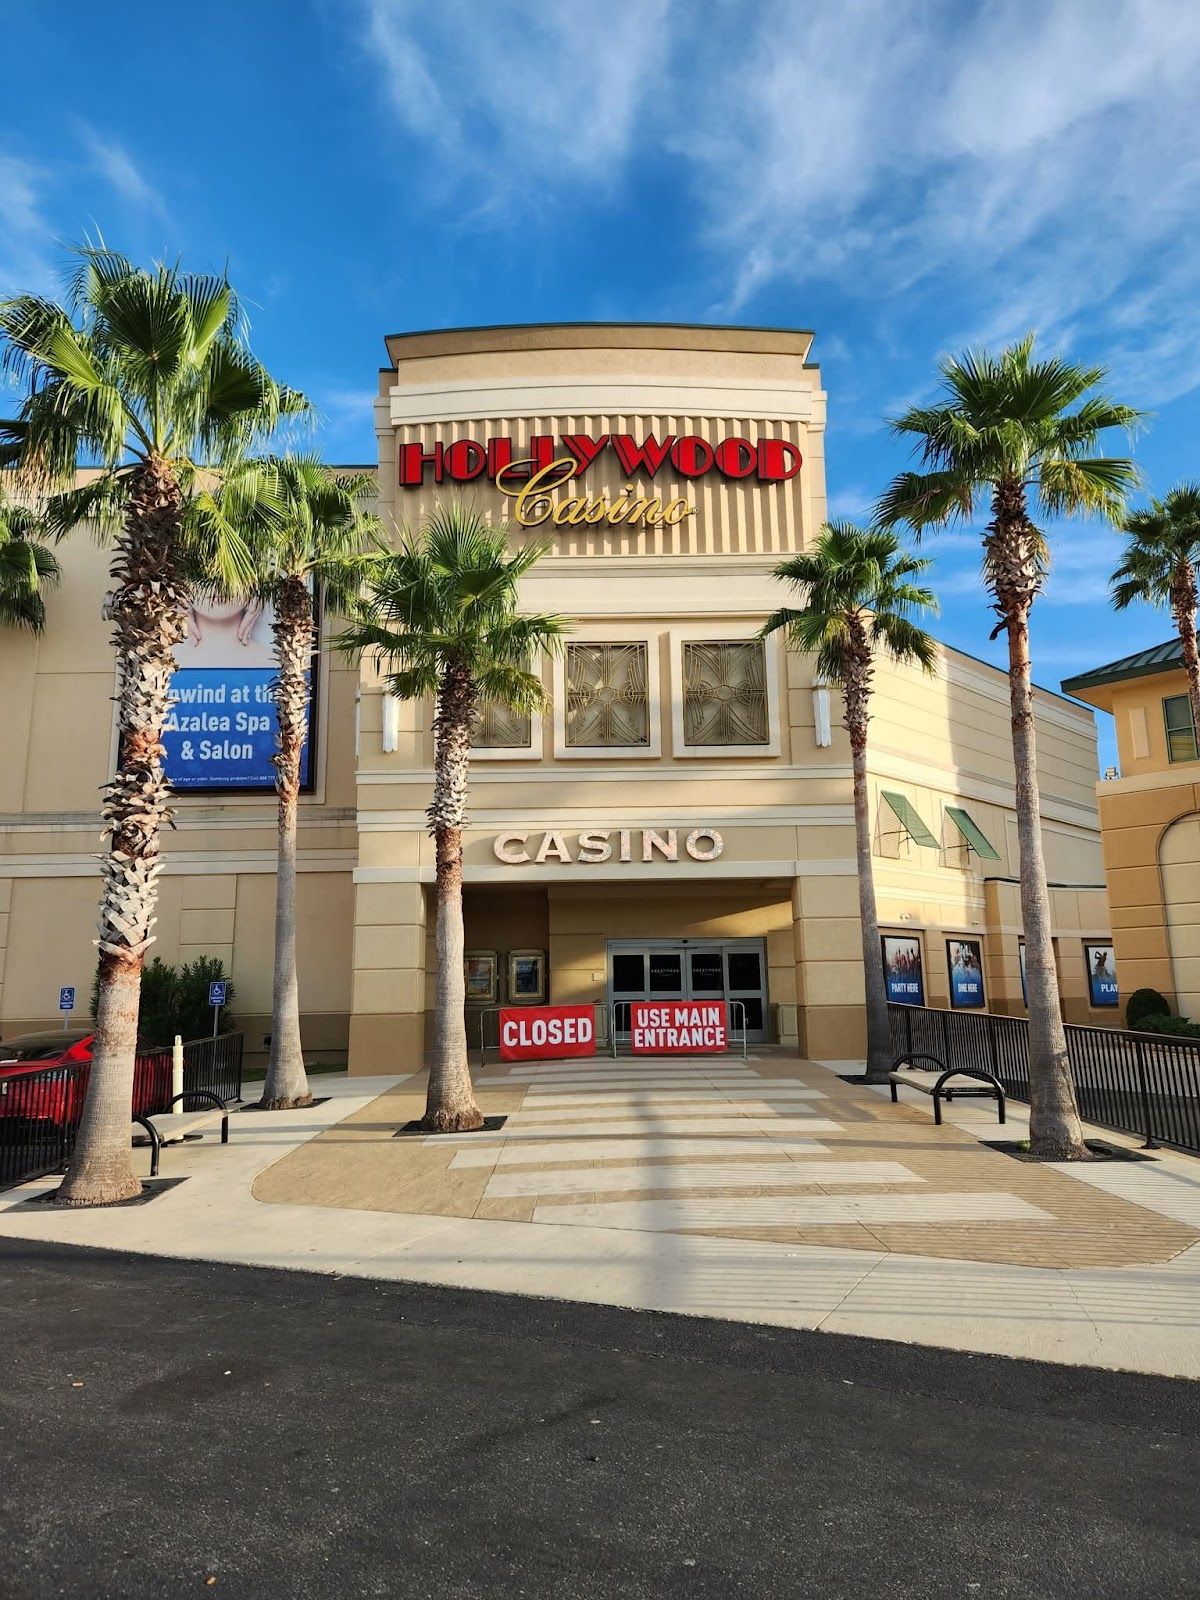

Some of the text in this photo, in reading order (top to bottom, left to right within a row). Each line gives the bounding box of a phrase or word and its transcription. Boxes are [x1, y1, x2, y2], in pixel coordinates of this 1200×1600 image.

[399, 432, 803, 486] HOLLYWOOD
[496, 457, 694, 527] Casino
[167, 684, 275, 704] nwind at th
[168, 711, 270, 736] Azalea Spa
[181, 740, 253, 761] & Salon
[493, 828, 724, 864] CASINO
[891, 982, 906, 993] PARTY
[637, 1007, 720, 1028] USE MAIN
[503, 1017, 593, 1047] CLOSED
[634, 1026, 726, 1048] ENTRANCE
